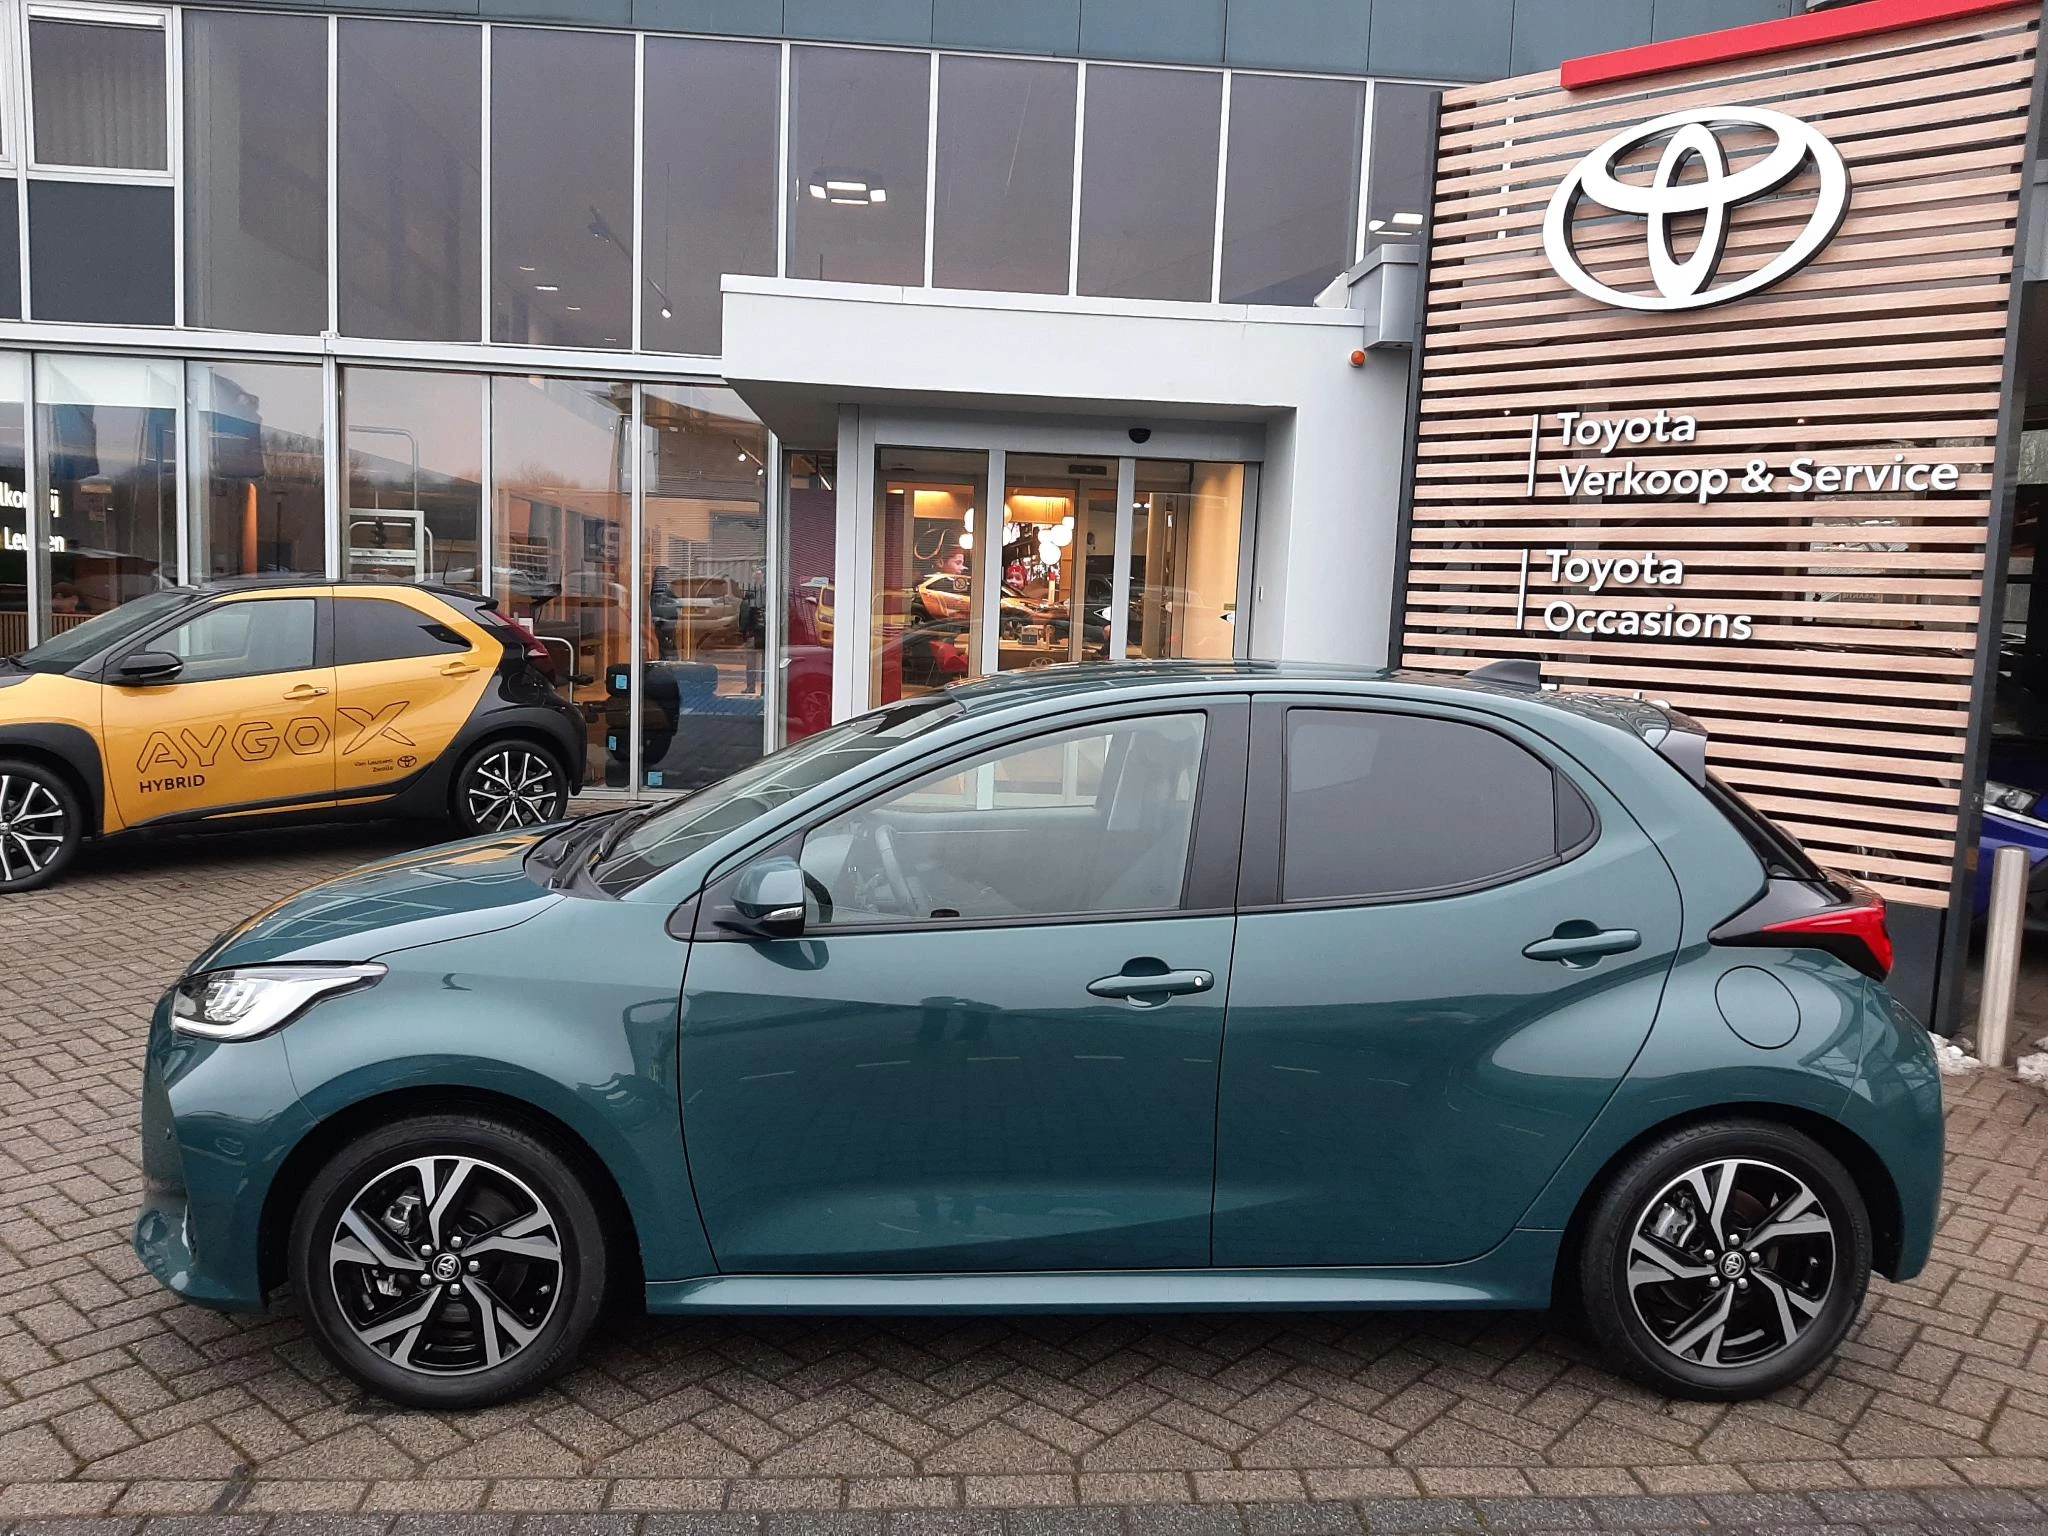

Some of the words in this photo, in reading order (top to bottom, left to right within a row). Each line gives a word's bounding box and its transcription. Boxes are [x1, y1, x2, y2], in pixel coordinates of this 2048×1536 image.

[1556, 409, 1697, 454] Toyota
[1558, 460, 1730, 505] Verkoop
[1740, 458, 1775, 495] &
[1787, 453, 1960, 493] Service
[1545, 548, 1685, 593] Toyota
[1543, 599, 1754, 641] Occasions
[136, 716, 331, 774] AYGO
[336, 700, 417, 756] X
[139, 774, 206, 794] HYBRID
